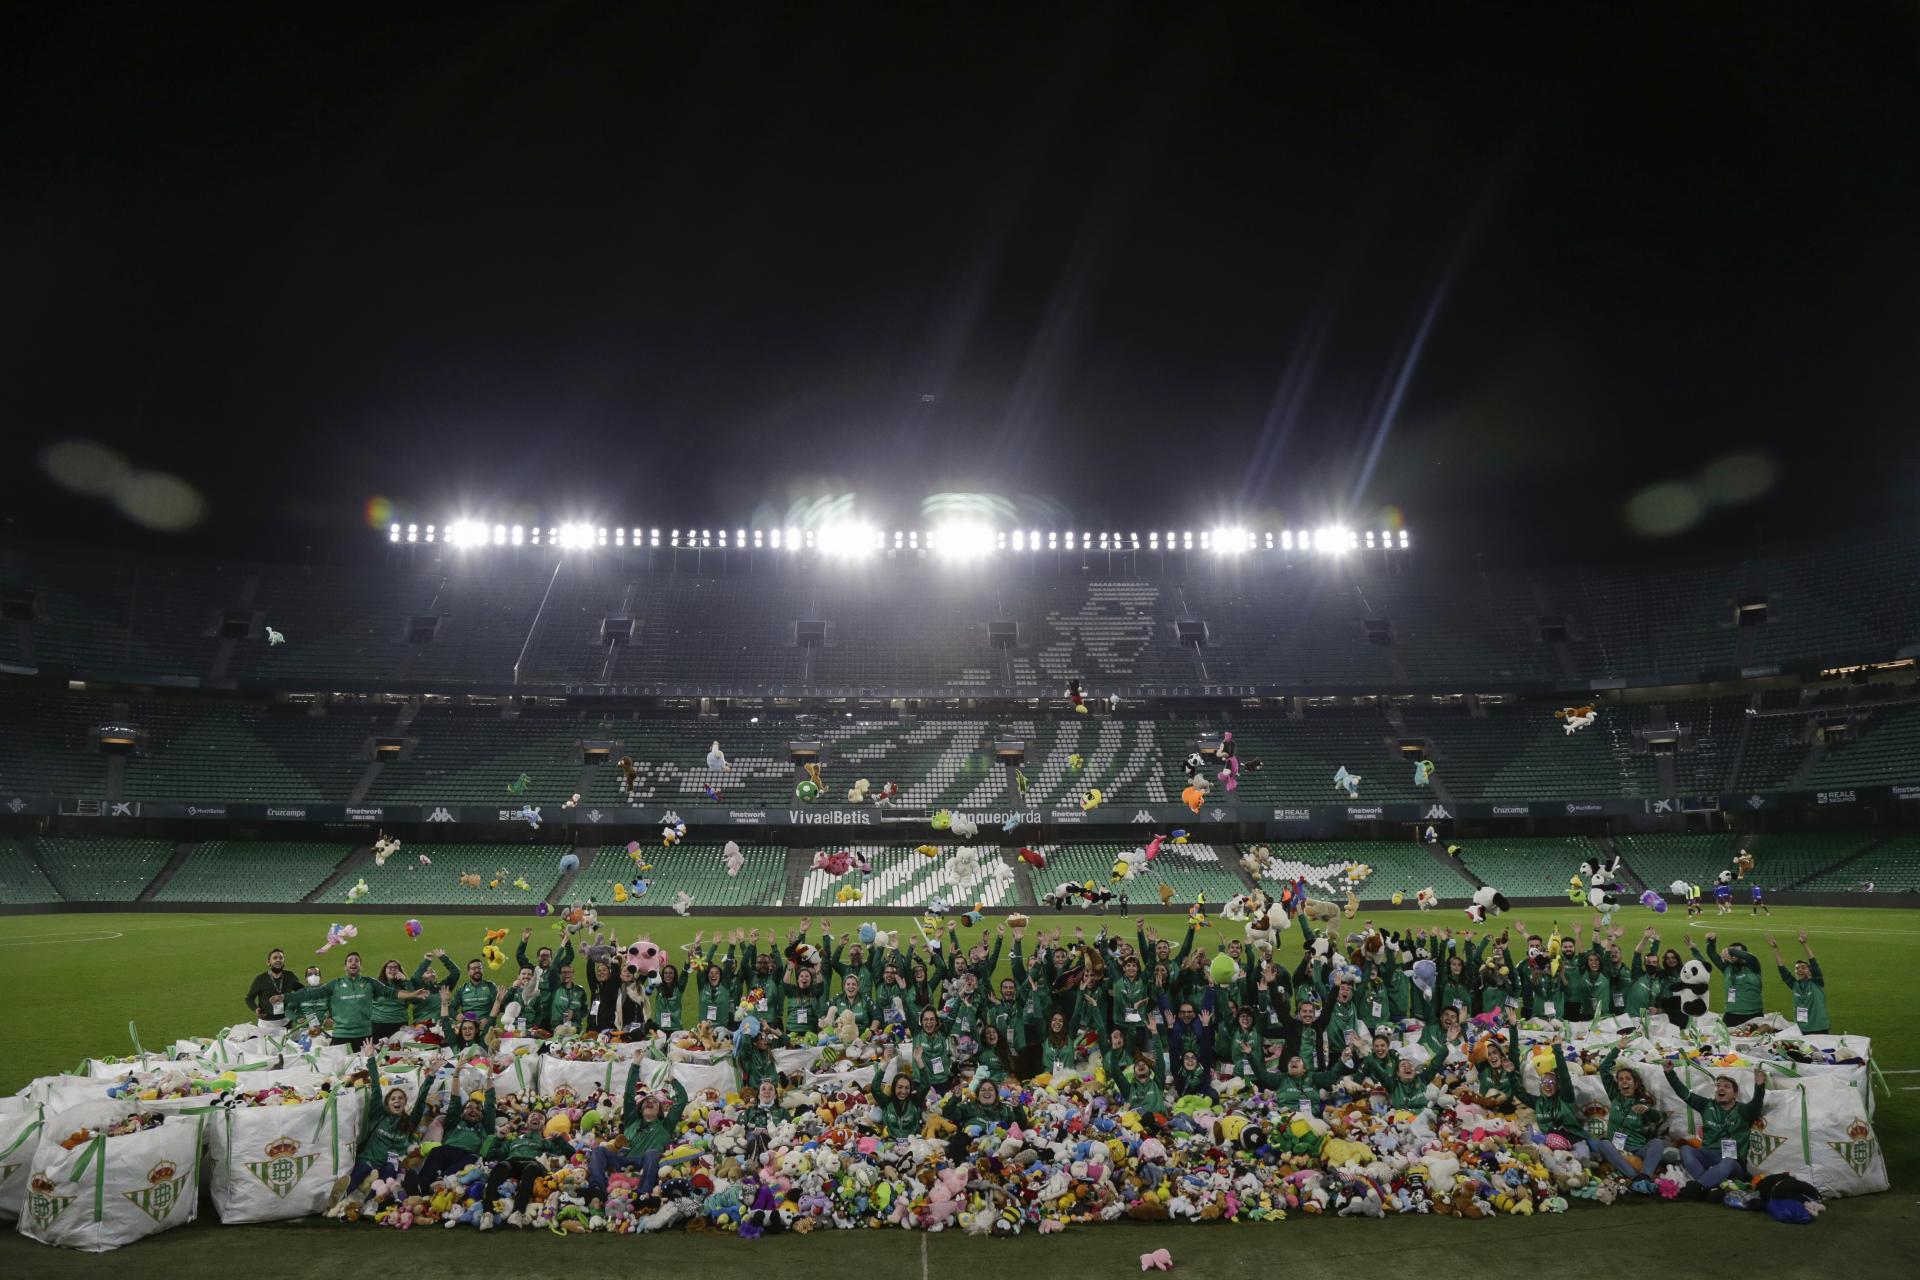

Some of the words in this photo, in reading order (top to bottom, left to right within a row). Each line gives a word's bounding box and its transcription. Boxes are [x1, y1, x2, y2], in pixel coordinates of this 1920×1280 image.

[1204, 686, 1256, 695] BETIS
[267, 808, 306, 818] Cruzcampo
[346, 807, 383, 815] finetwork
[1493, 806, 1528, 814] Cruzcampo
